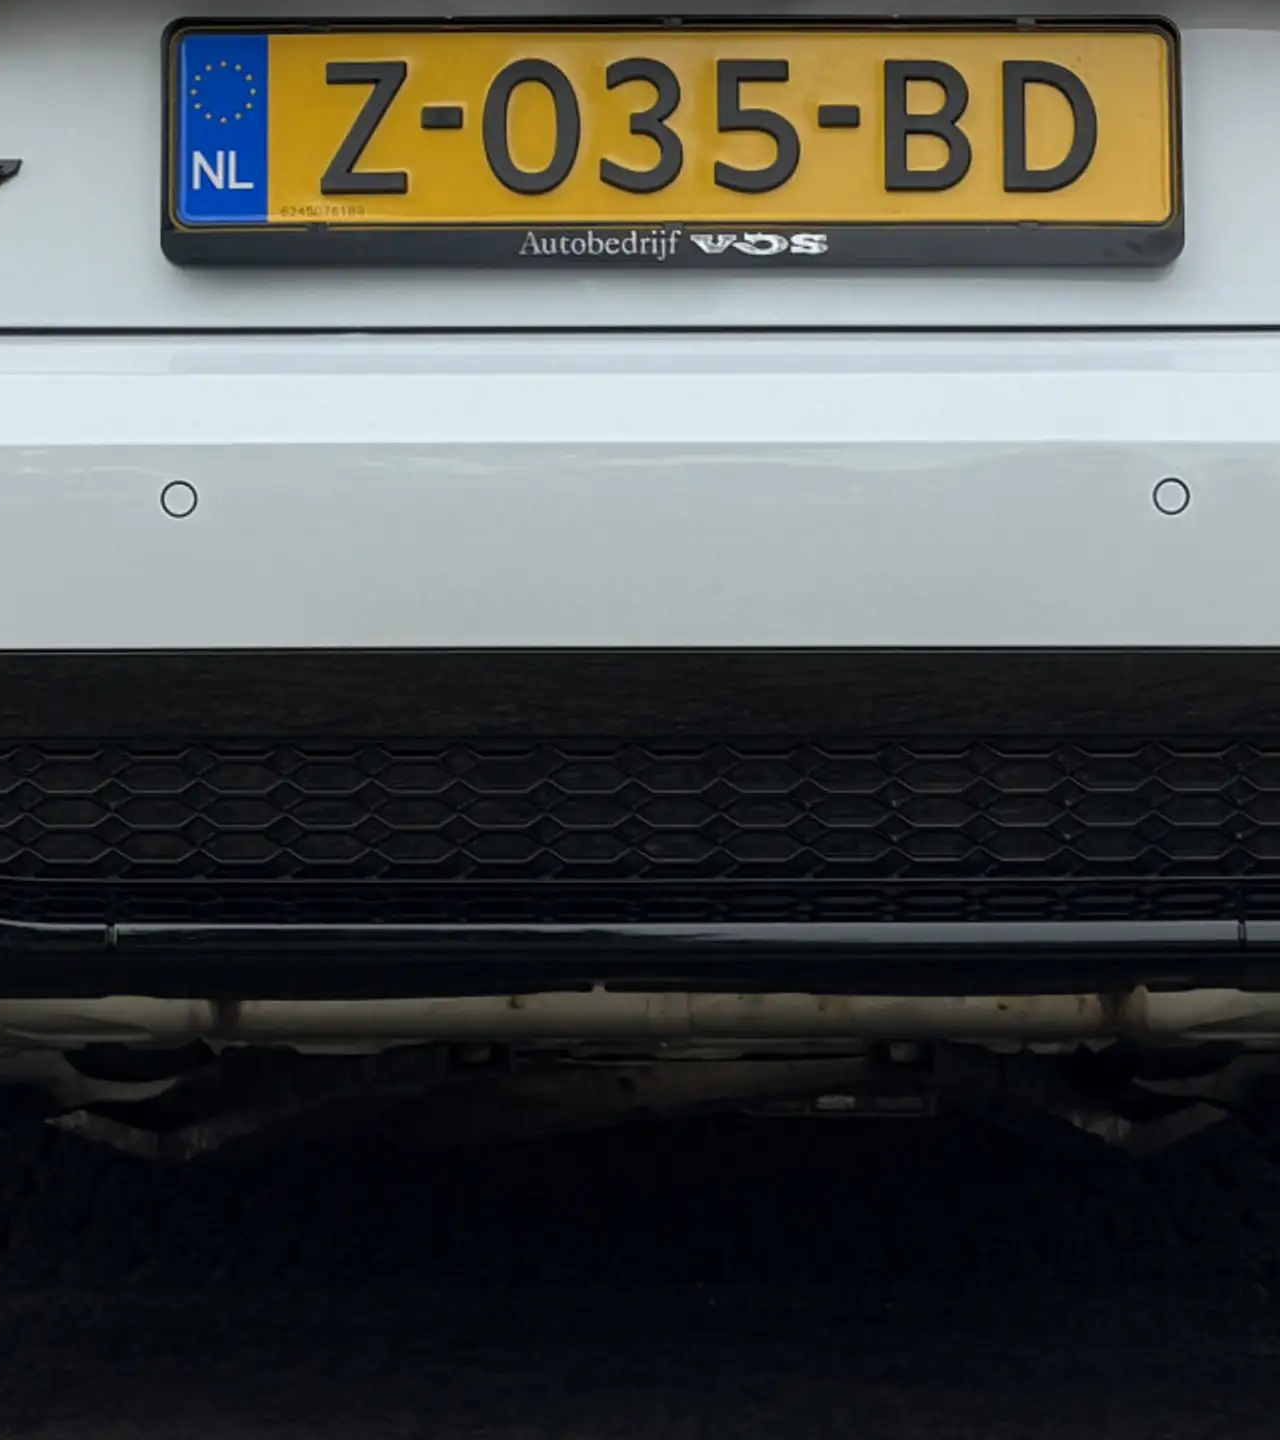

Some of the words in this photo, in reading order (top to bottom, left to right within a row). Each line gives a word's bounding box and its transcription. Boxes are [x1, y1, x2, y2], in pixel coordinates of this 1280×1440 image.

[319, 58, 1098, 195] Z-035-BD
[192, 150, 254, 190] NL
[519, 230, 682, 261] Autobedrijf
